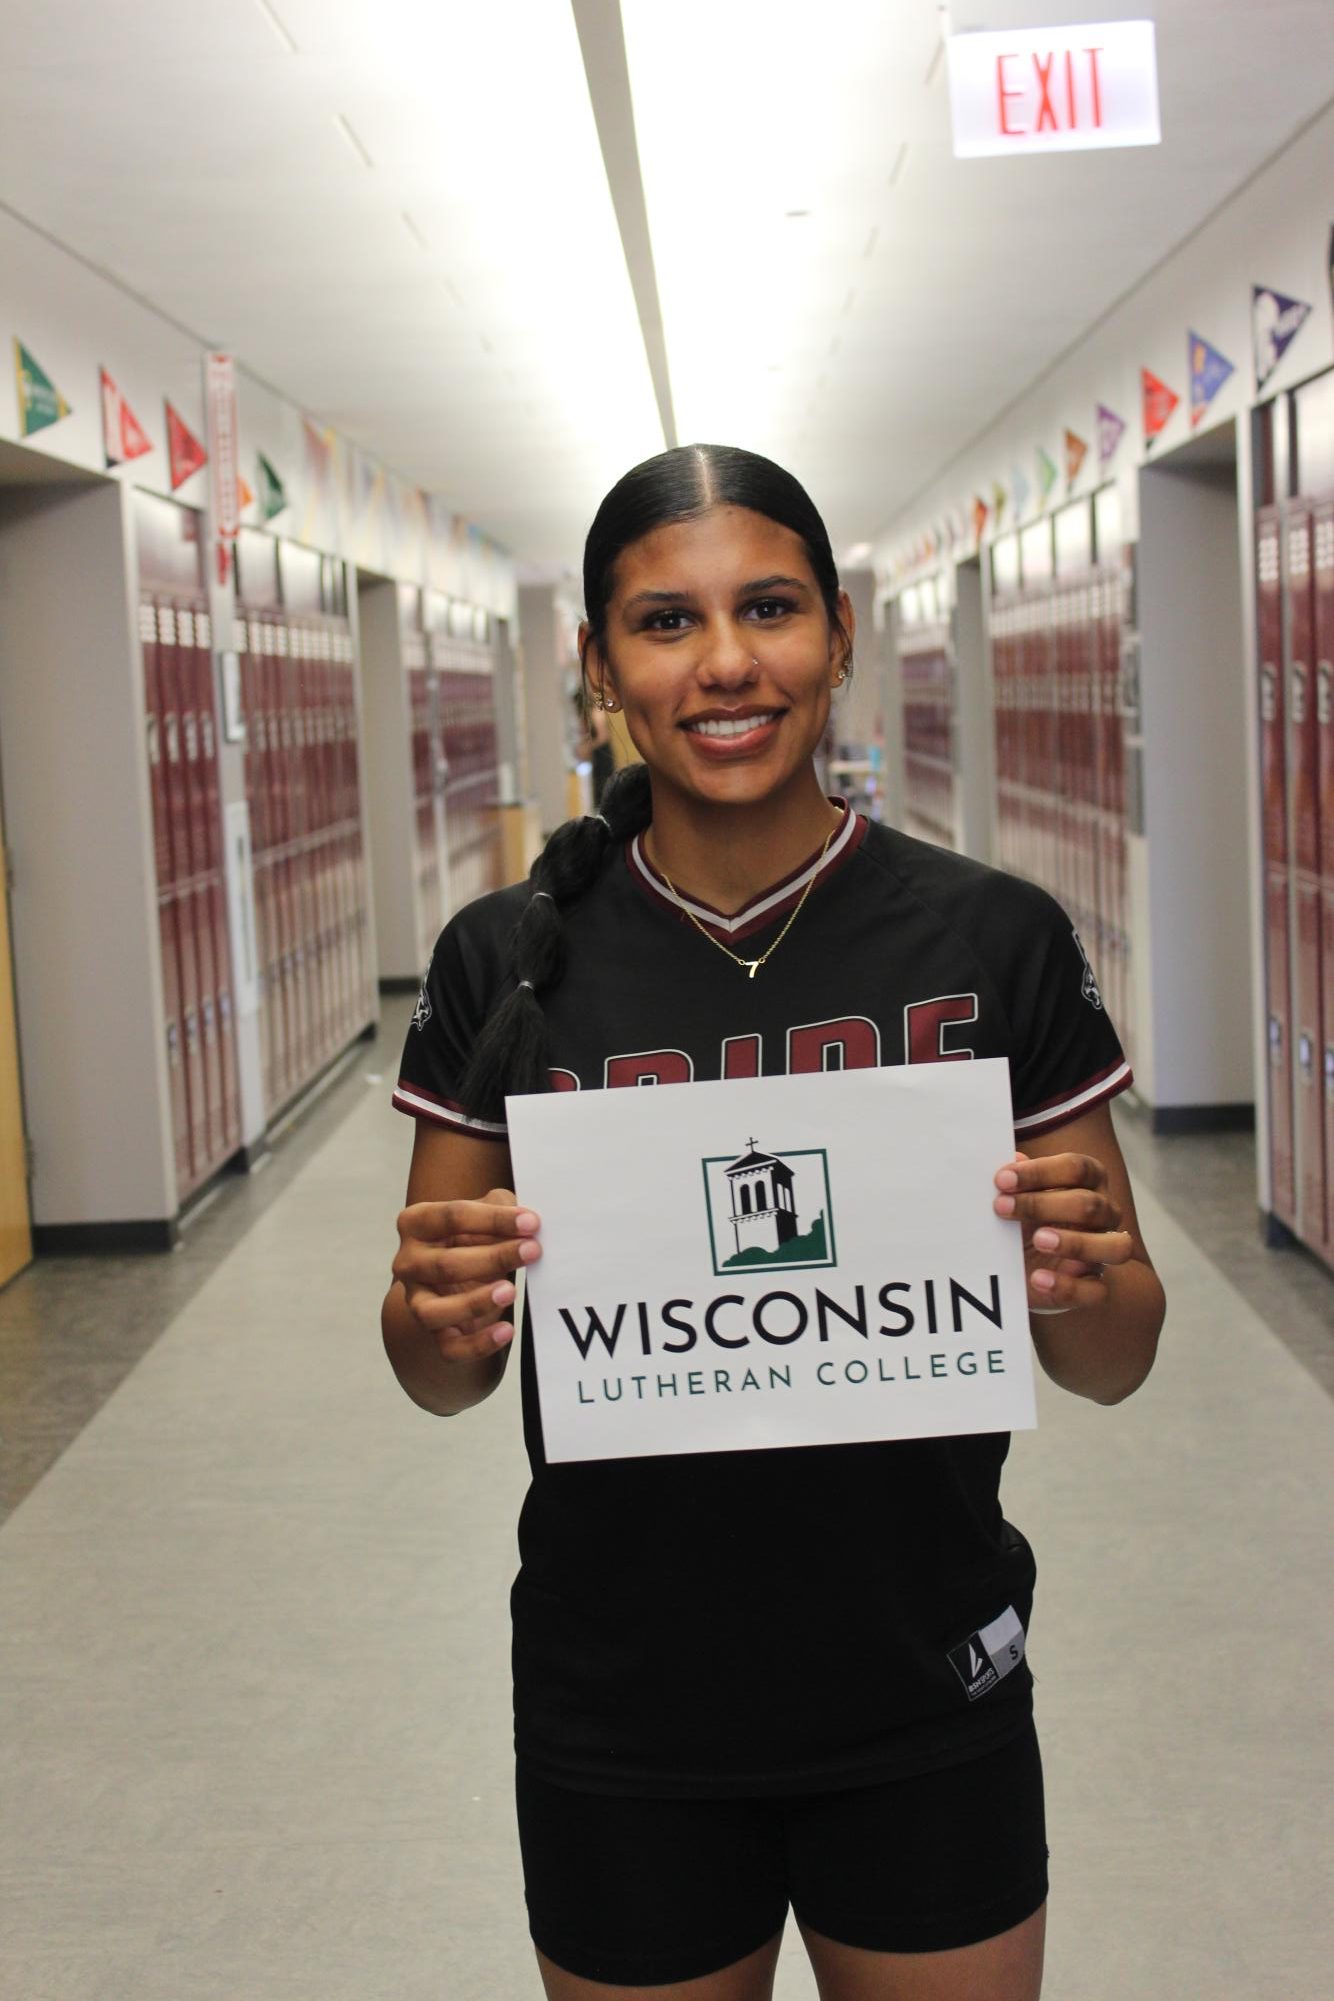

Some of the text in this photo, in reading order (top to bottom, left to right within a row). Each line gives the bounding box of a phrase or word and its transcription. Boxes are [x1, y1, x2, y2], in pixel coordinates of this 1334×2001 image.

[995, 47, 1105, 137] EXIT
[744, 960, 760, 979] 7
[557, 1274, 1003, 1361] WISCONSIN
[577, 1349, 1006, 1404] LUTHERAN COLLEGE
[1009, 1644, 1019, 1661] S
